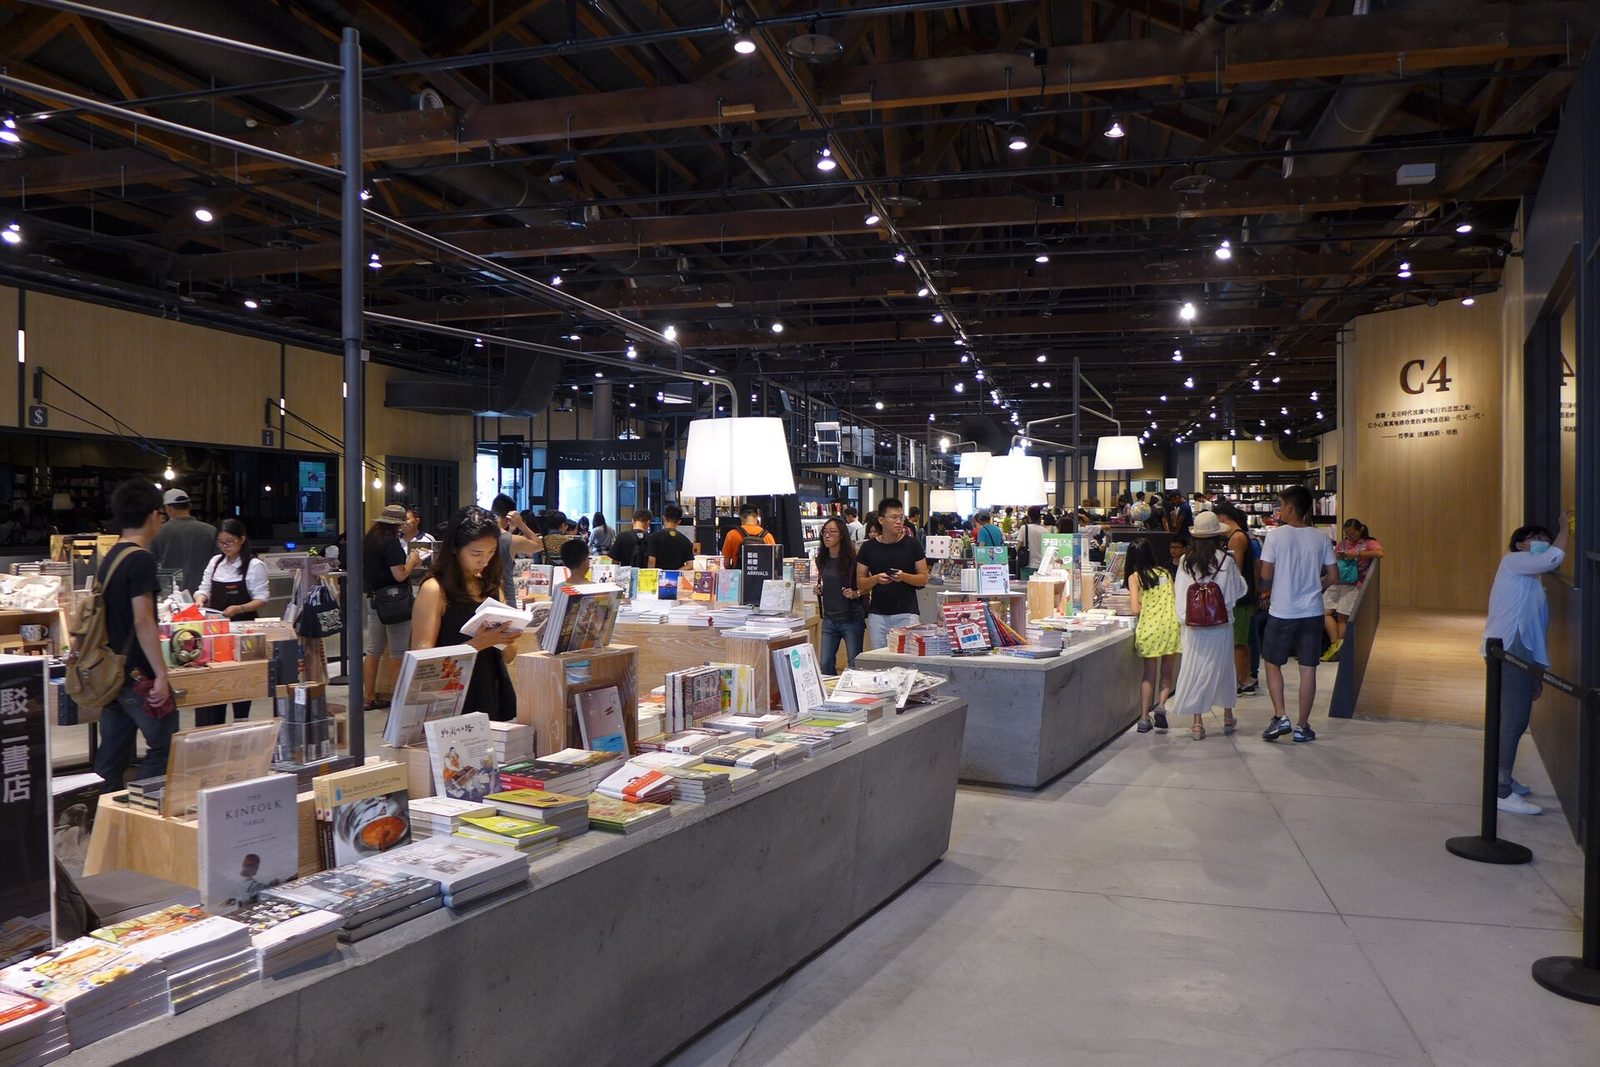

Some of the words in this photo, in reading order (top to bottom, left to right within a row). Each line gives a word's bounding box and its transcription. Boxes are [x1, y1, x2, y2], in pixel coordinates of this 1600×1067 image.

[1400, 356, 1452, 394] C4
[0, 686, 31, 803] 駁二書店
[225, 800, 283, 820] KINFOLK
